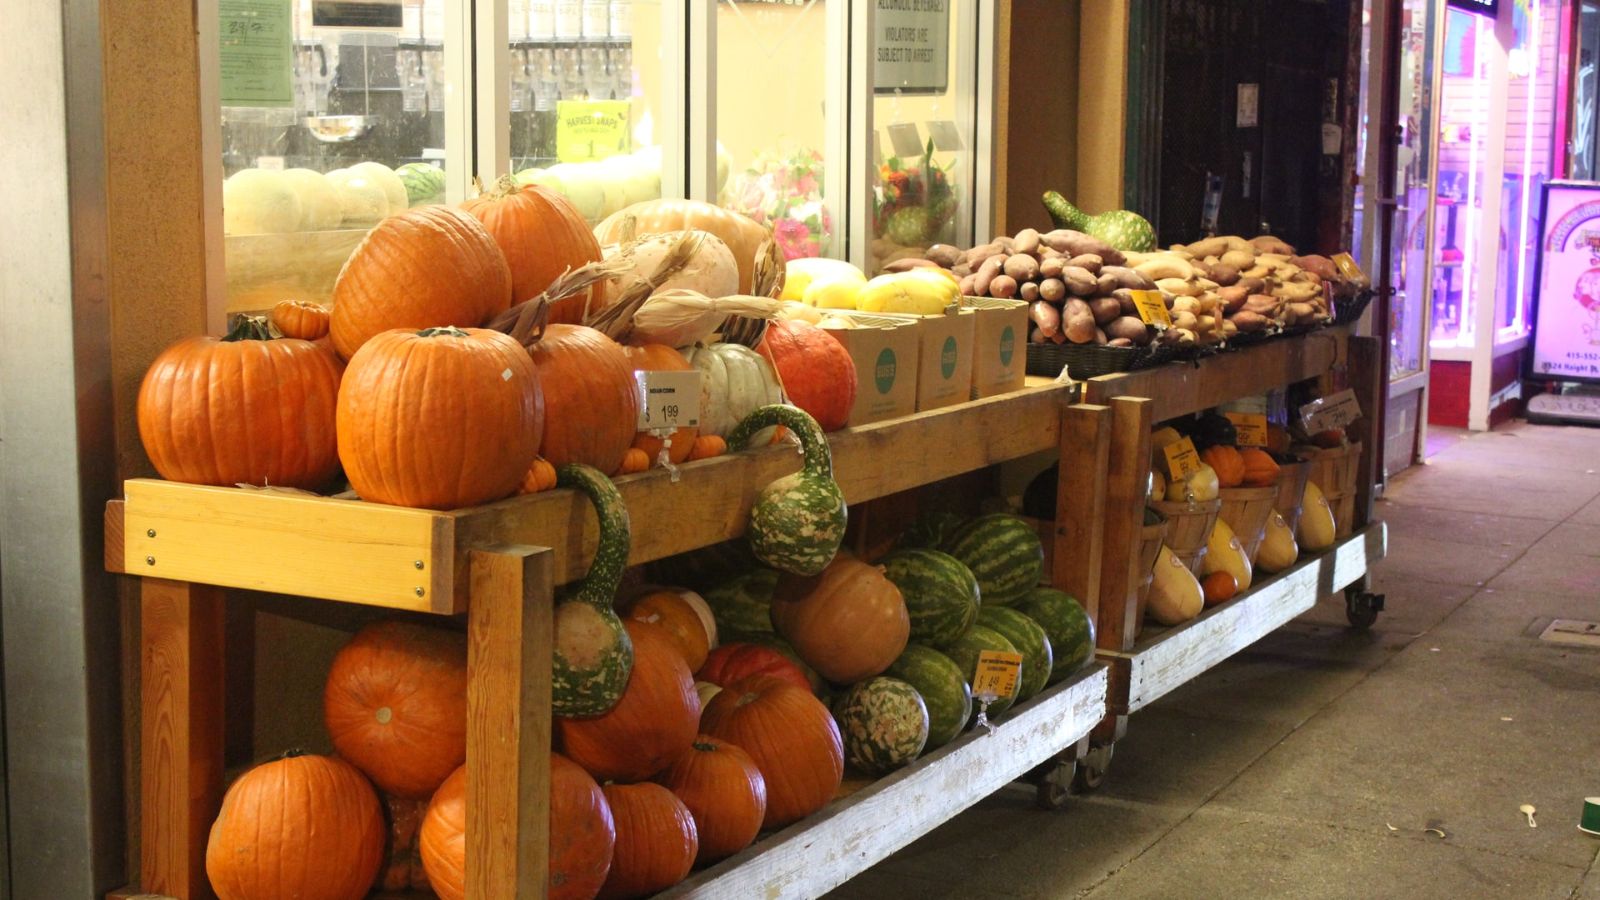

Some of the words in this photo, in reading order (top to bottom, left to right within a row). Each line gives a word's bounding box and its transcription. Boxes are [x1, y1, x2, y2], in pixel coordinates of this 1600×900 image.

[885, 27, 916, 42] VIOLATORS
[917, 28, 928, 42] ARE
[878, 47, 903, 62] SUBJECT
[904, 48, 912, 62] TO
[912, 48, 934, 63] ARREST
[1564, 363, 1588, 373] Haight
